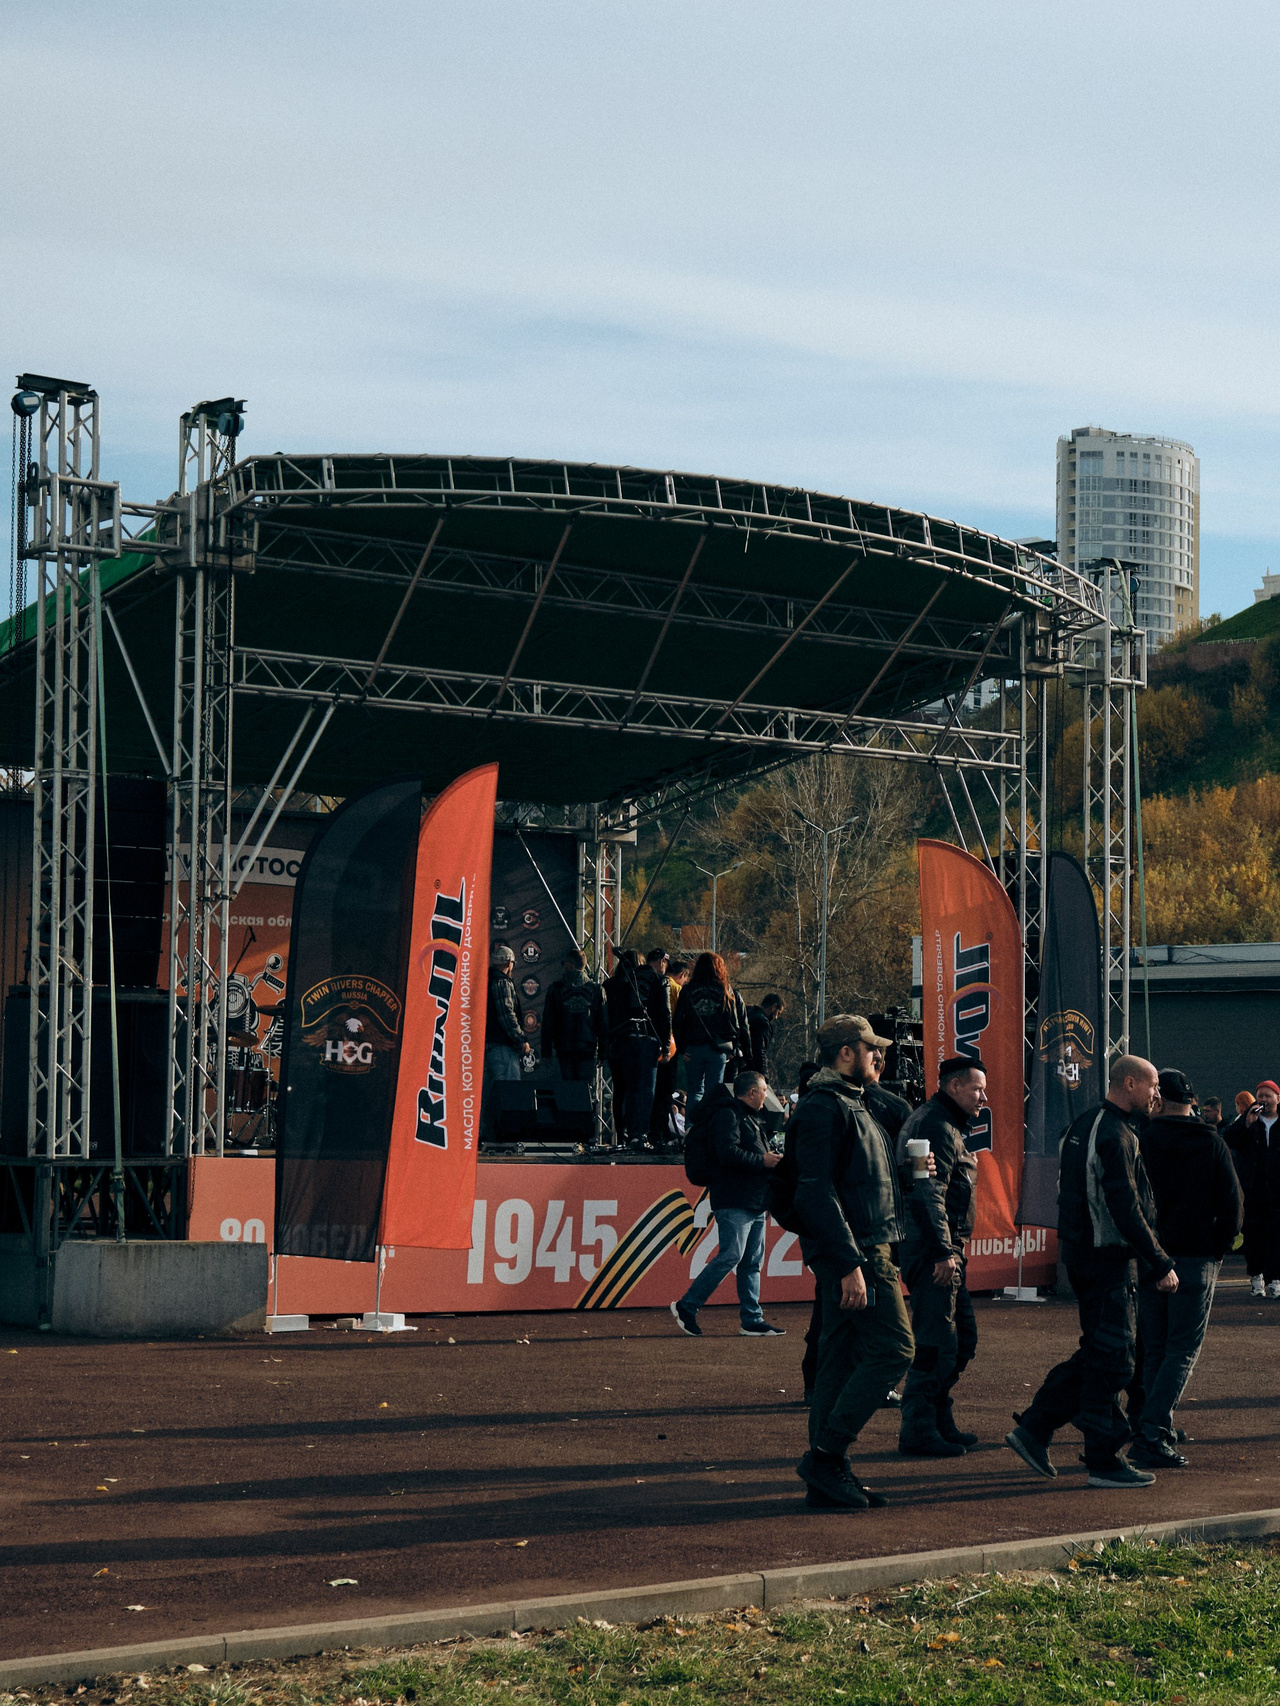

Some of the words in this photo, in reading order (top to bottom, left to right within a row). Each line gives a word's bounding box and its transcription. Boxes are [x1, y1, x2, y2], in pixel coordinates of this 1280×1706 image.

[463, 873, 476, 948] ДОВЕРЯ
[306, 985, 330, 1005] TWIN
[330, 979, 363, 991] RIVERS
[365, 982, 398, 1012] CHAPTER
[341, 991, 368, 1001] RUSSIA
[460, 951, 471, 1008] МОЖНО
[460, 1012, 473, 1091] КОТОРОМУ
[463, 1094, 475, 1150] МАСЛО,
[466, 1198, 618, 1285] 1945
